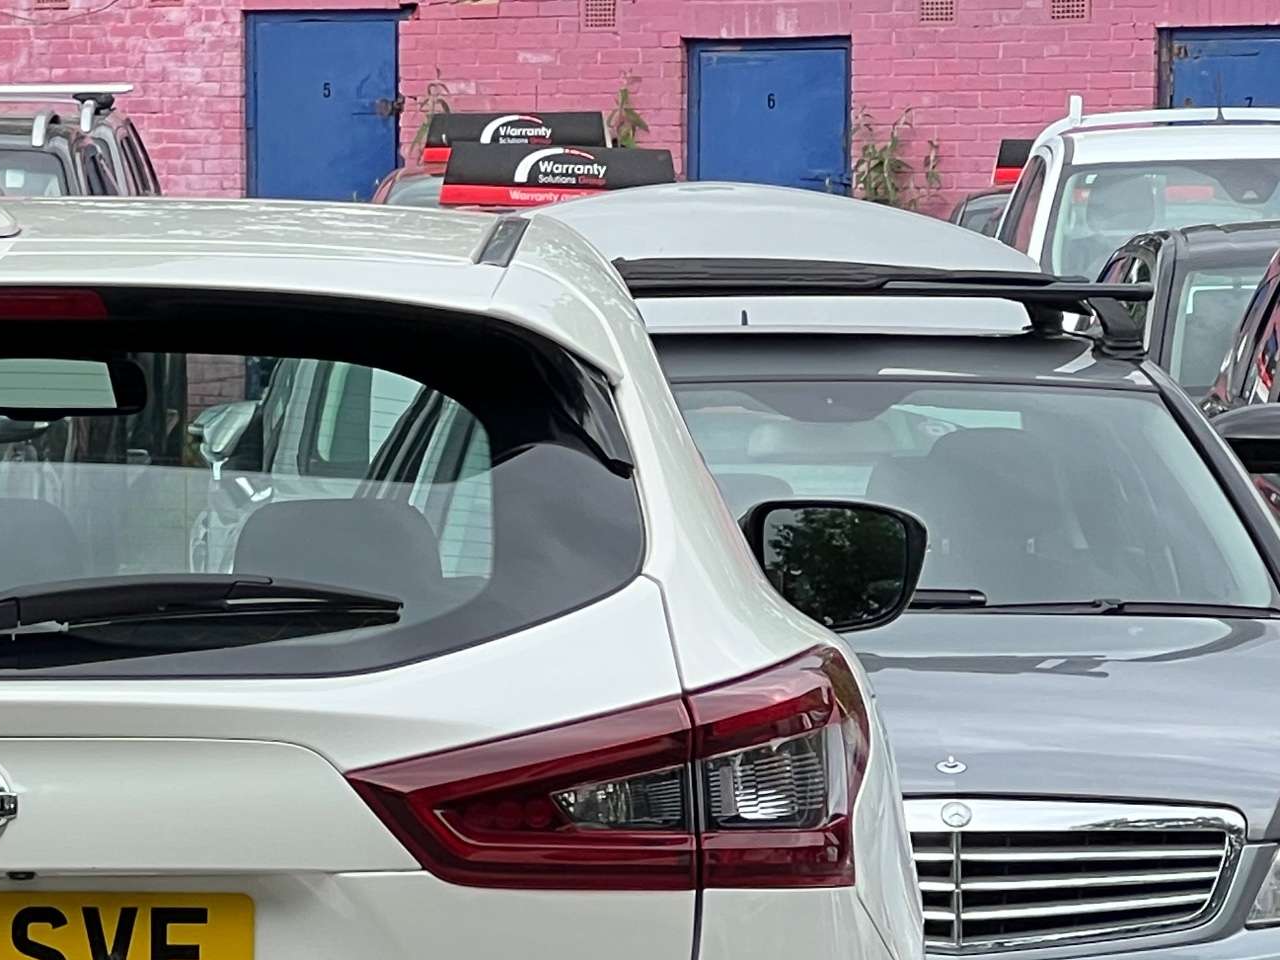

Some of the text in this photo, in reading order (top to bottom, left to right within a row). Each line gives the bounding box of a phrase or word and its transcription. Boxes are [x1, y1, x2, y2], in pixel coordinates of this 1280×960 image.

[323, 82, 331, 98] 5
[767, 93, 776, 109] 6
[498, 126, 552, 138] Warranty
[538, 161, 607, 178] Warranty
[537, 174, 577, 184] Solutions
